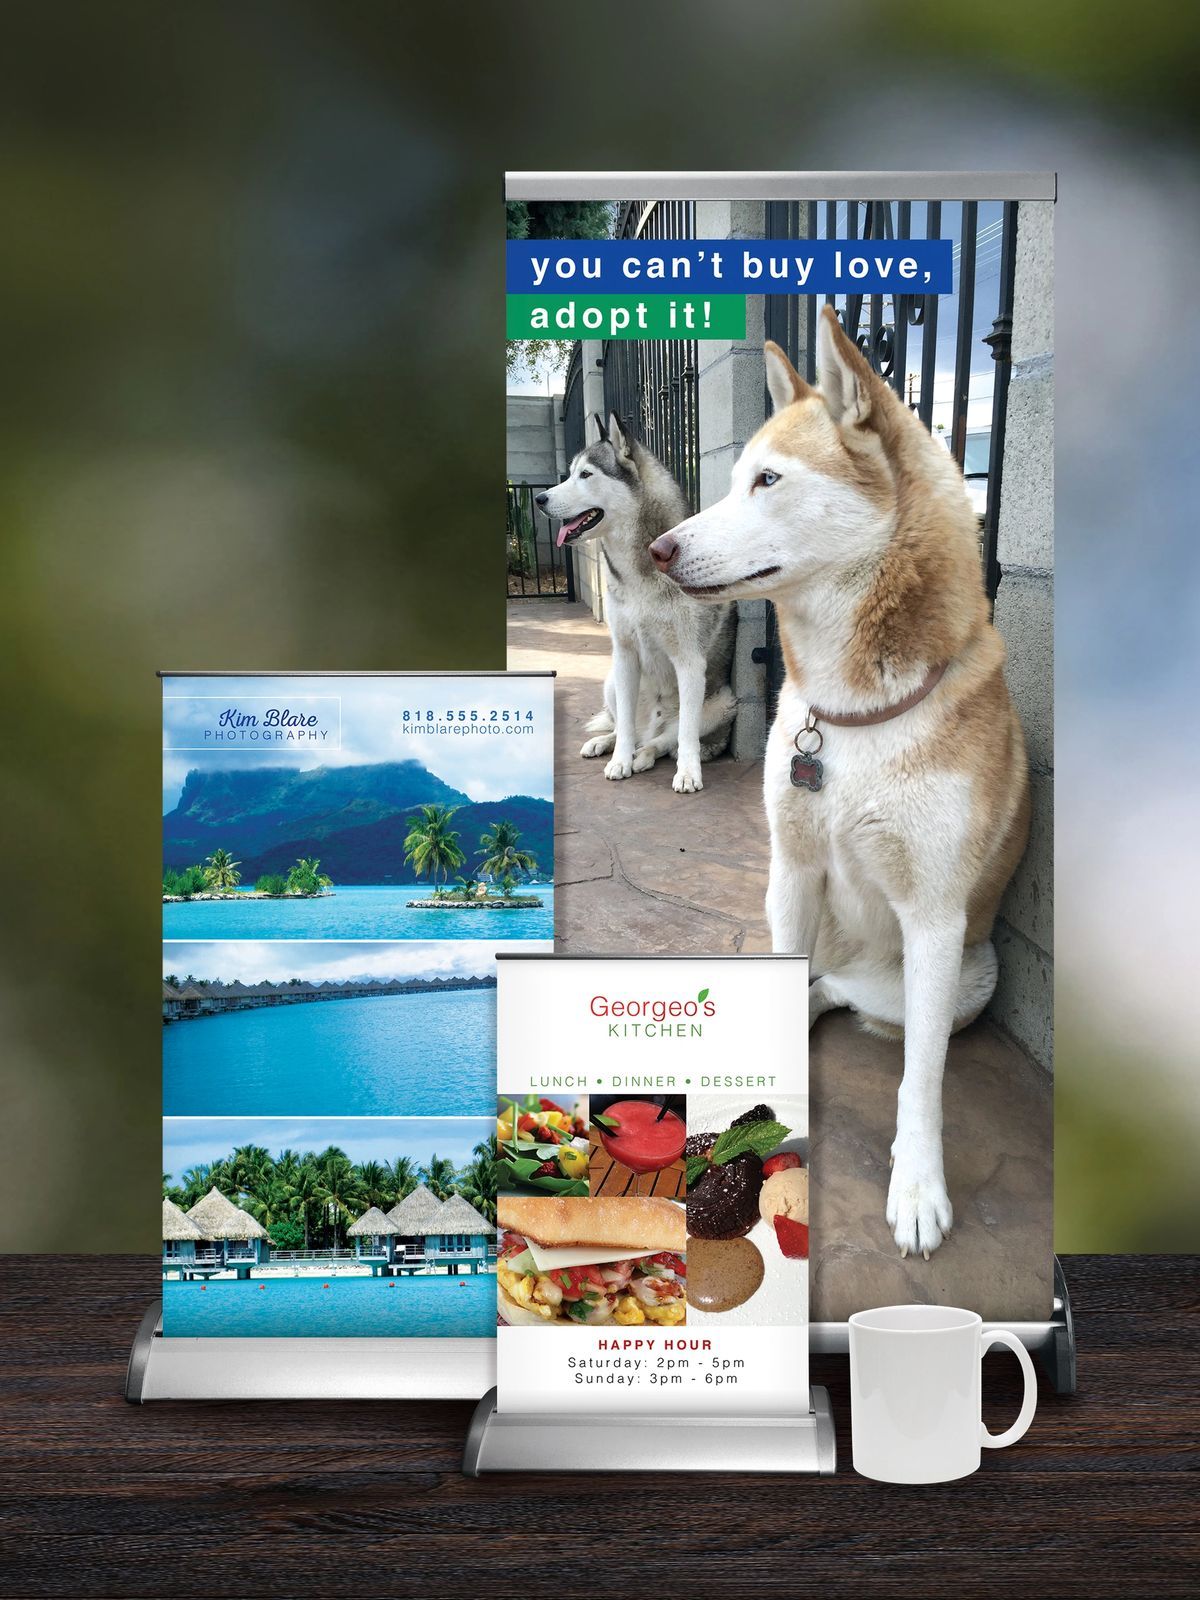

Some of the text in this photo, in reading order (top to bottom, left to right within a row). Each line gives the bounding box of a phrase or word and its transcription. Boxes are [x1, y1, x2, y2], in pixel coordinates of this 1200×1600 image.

[532, 258, 601, 285] you
[744, 252, 815, 285] buy
[836, 251, 931, 283] love,
[531, 302, 711, 335] adopt it!
[219, 709, 319, 728] Kim Blare
[403, 711, 534, 721] 818.555.2514
[204, 730, 329, 741] PHOTOGRAPHY
[403, 724, 534, 736] kimblarephoto.com
[609, 1024, 702, 1037] KITCHEN
[531, 1076, 777, 1087] LUNCH DINNER DESSERT
[599, 1340, 712, 1350] HAPPY HOUR
[568, 1357, 647, 1370] Saturday:
[657, 1357, 689, 1370] 2pm
[713, 1357, 745, 1370] 5pm
[575, 1373, 640, 1386] Sunday:
[650, 1373, 682, 1386] 3pm
[705, 1373, 738, 1385] 6pm
